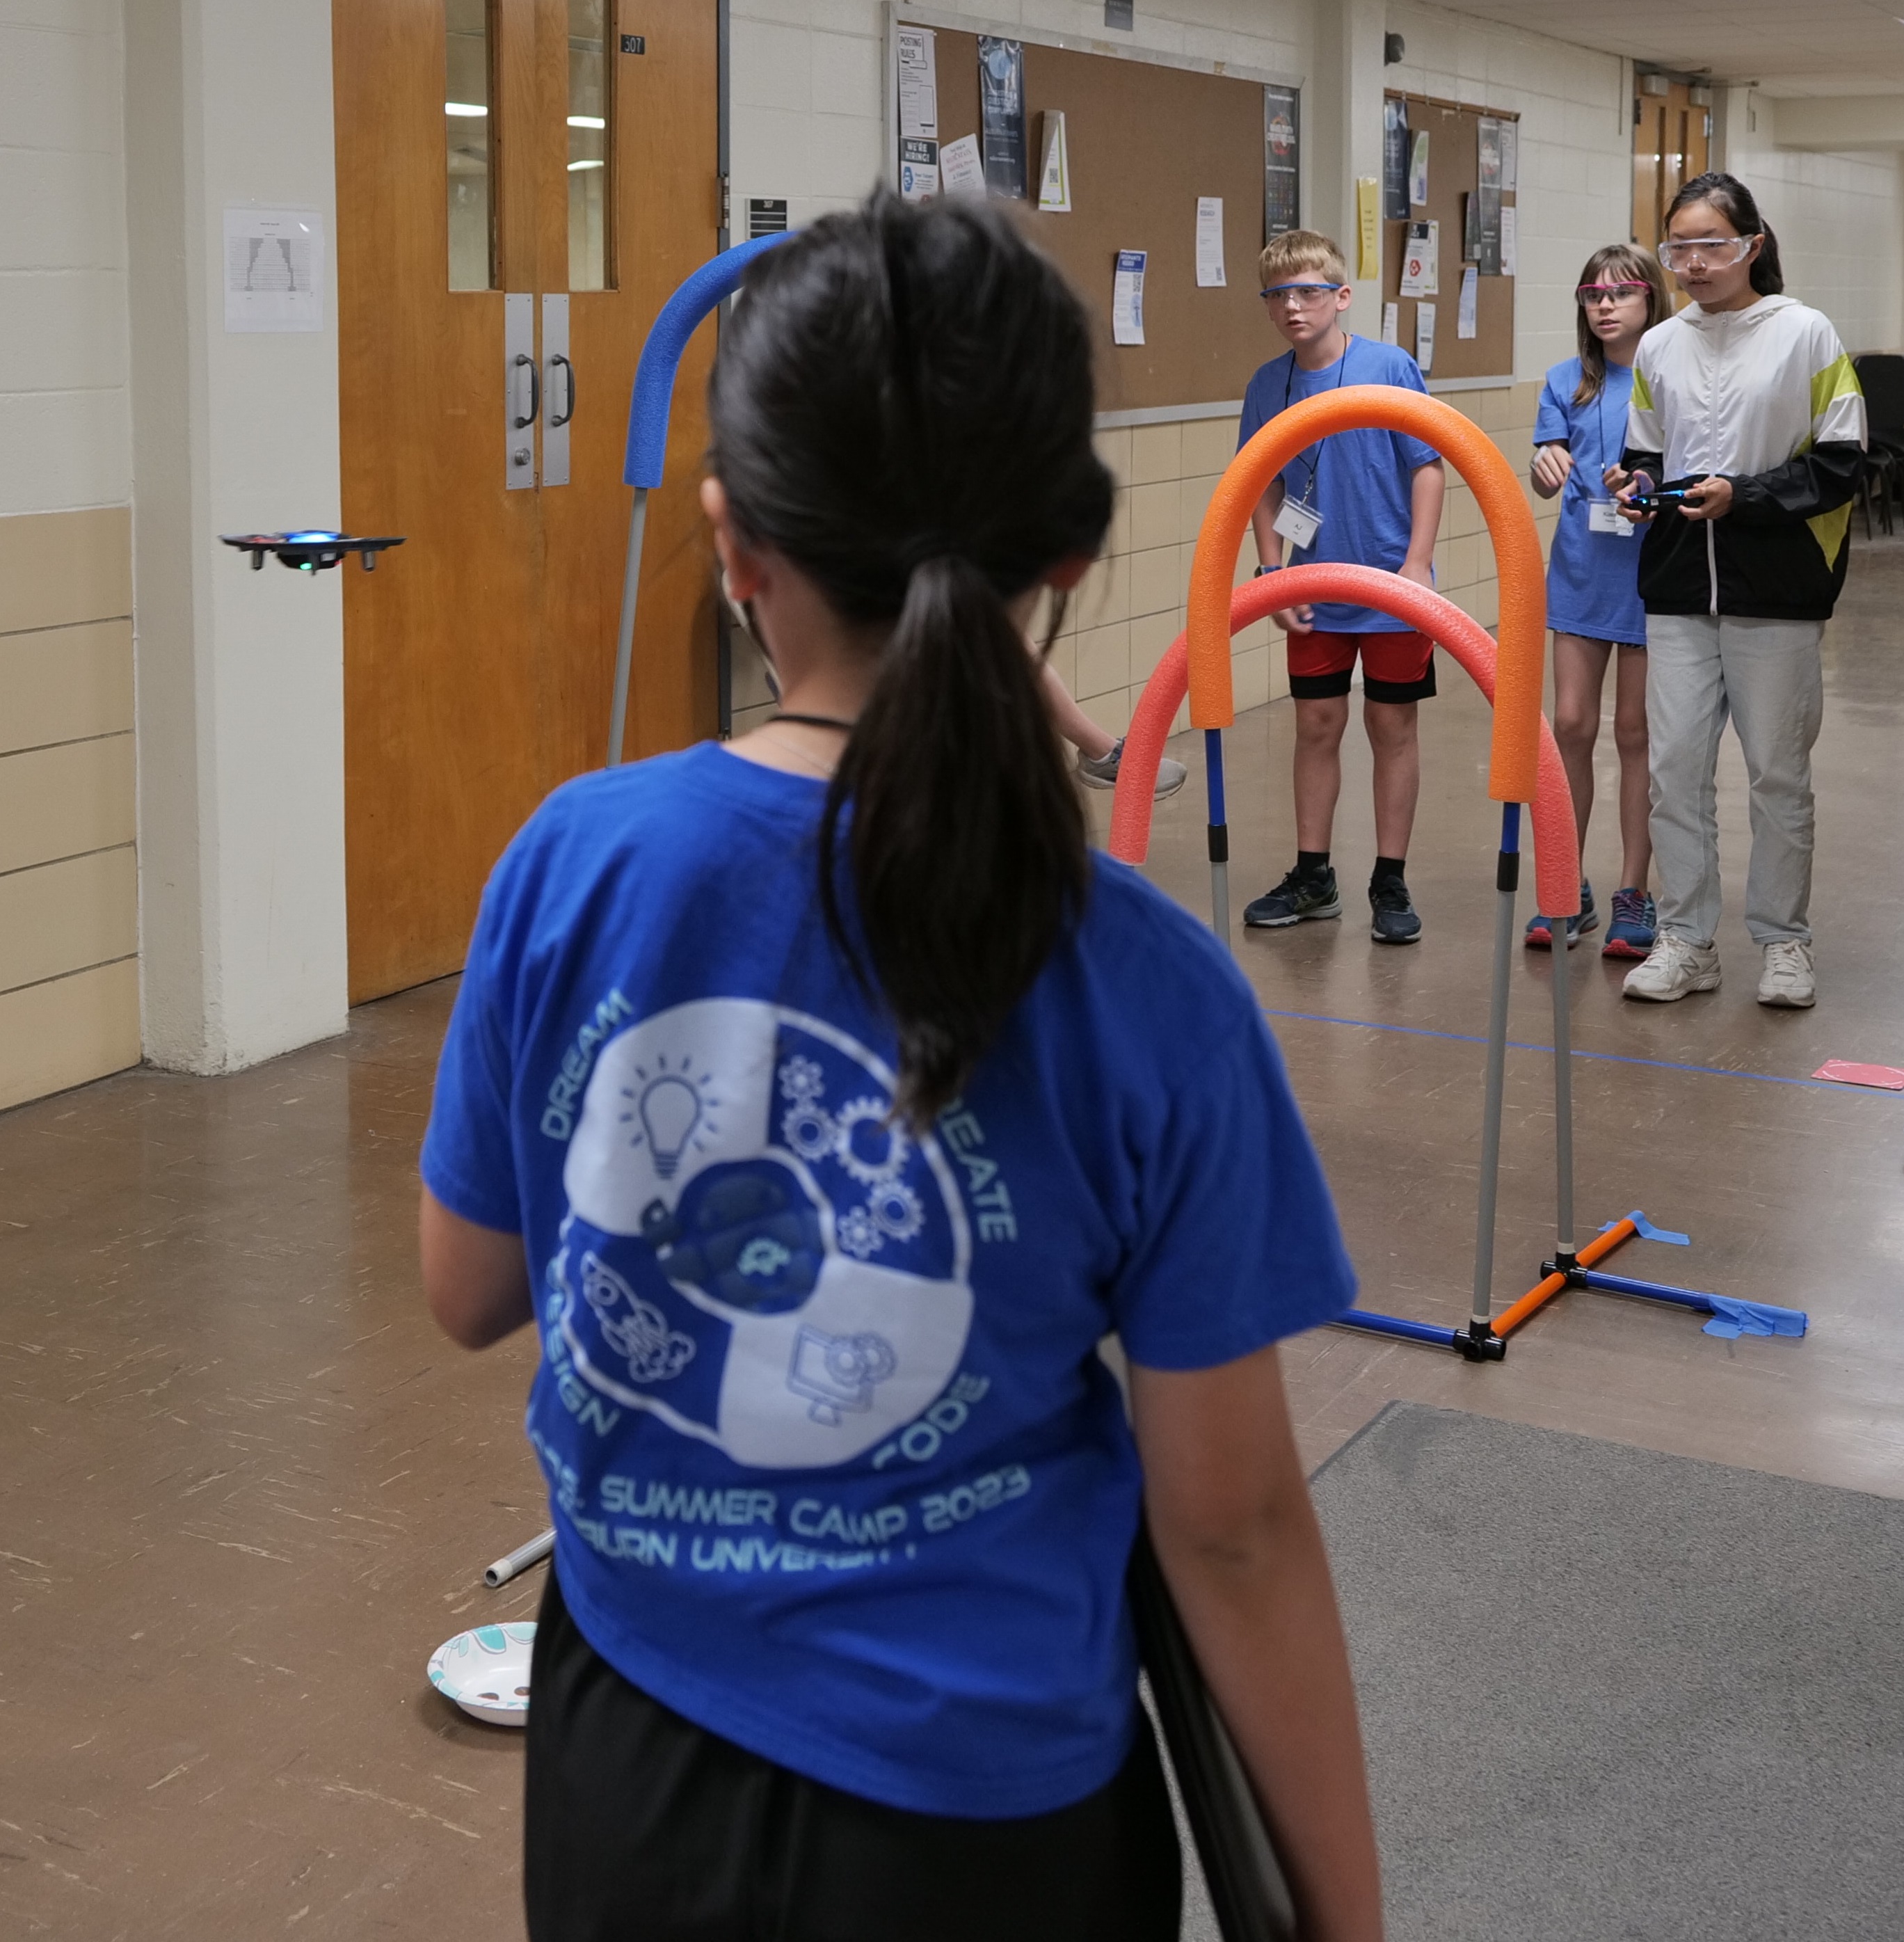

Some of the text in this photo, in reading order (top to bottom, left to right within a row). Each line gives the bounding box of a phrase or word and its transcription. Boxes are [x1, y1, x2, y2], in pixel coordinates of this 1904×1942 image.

[540, 987, 634, 1143] DREAM
[939, 1097, 1018, 1243] EATE
[600, 1464, 1031, 1545] SUMMER CAMP 2023
